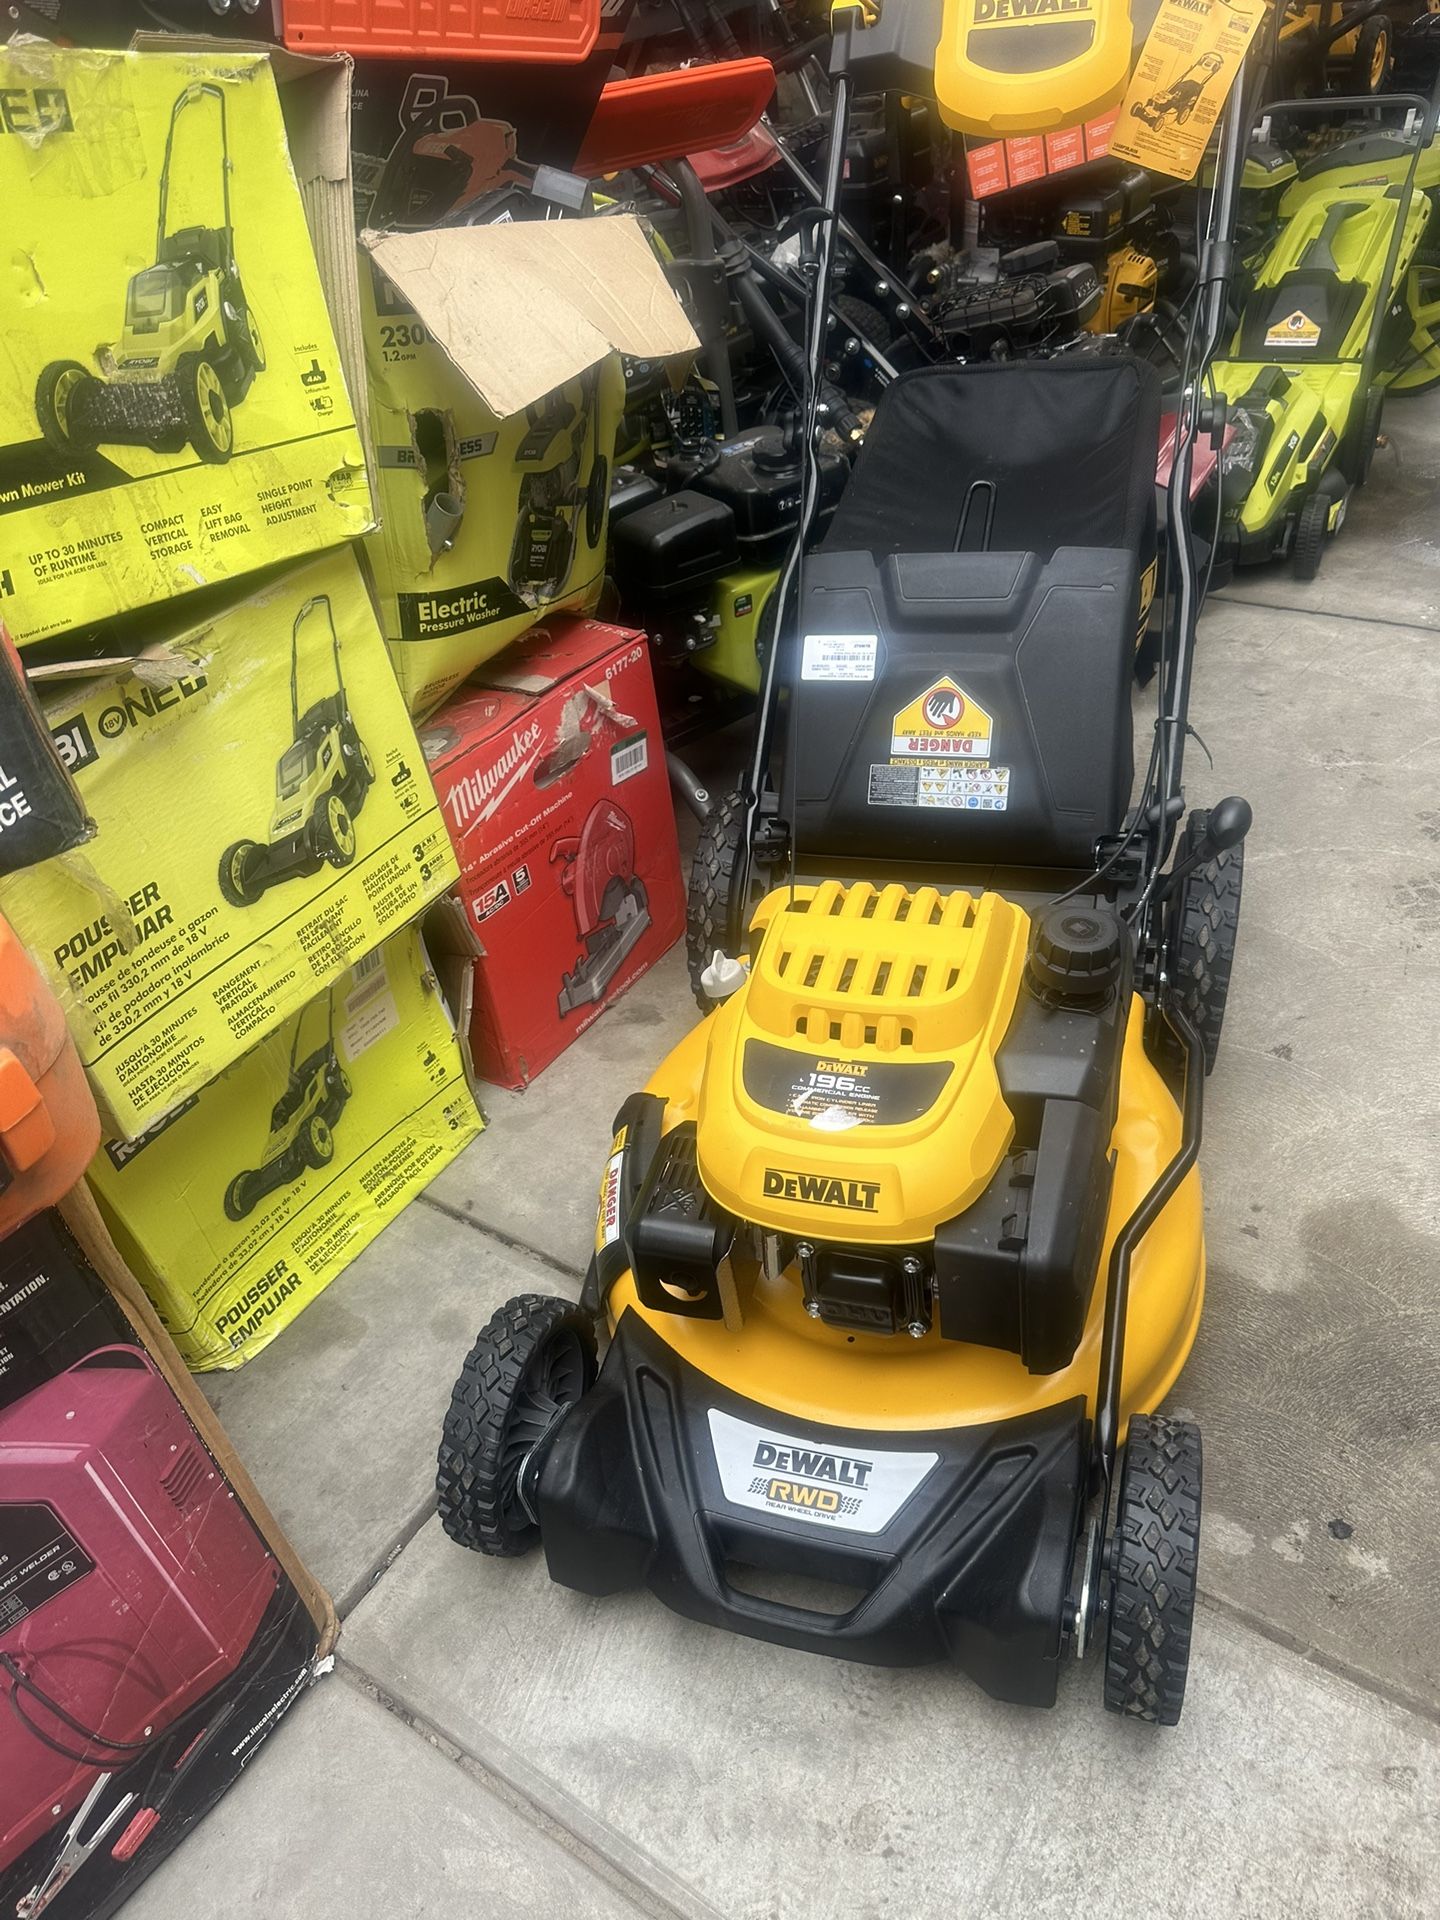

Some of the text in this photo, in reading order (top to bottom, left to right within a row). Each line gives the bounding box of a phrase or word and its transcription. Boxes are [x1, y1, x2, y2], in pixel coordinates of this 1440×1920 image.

[293, 343, 317, 352] Includes
[380, 324, 432, 348] 230
[397, 439, 482, 463] BRESS
[21, 479, 65, 498] Mower
[66, 472, 86, 487] Kit
[257, 479, 313, 501] SINGLE POINT
[200, 503, 222, 517] EASY
[205, 512, 242, 530] LIFT BAG
[261, 498, 292, 513] HEIGHT
[266, 504, 317, 526] ADJUSTMENT
[141, 514, 184, 533] COMPACT
[145, 528, 188, 547] VERTICAL
[209, 523, 251, 542] REMOVAL
[28, 531, 123, 565] UP TO 30 MINUTES
[150, 540, 193, 560] STORAGE
[34, 551, 97, 578] OF RUNTIME
[418, 592, 487, 621] Electric
[419, 607, 500, 633] Pressure Washer
[605, 646, 643, 680] 6177-20
[104, 715, 120, 731] 18V
[908, 738, 973, 752] DANGER
[443, 720, 543, 828] Milwaukee
[479, 836, 514, 863] Abrasive
[514, 813, 542, 837] Cut-Off
[542, 791, 573, 817] Machine
[390, 854, 399, 864] DE
[412, 833, 437, 862] 3 ANS
[364, 869, 393, 893] HAUTEUR
[367, 862, 412, 901] POINT UNIQUE
[420, 863, 432, 881] 3
[372, 883, 403, 912] AJUSTE DE
[375, 881, 418, 919] ALTURA DE UN
[476, 883, 508, 913] 15A
[516, 868, 526, 881] 5
[296, 895, 349, 938] RETRAIT DU SAC
[377, 892, 417, 926] SOLO PUNTO
[54, 881, 161, 970] POUSER
[299, 934, 311, 945] EN
[117, 907, 219, 981] de tondeuse gazon
[307, 942, 331, 964] RETIRO
[311, 935, 353, 970] DE LA BOLSA
[108, 925, 208, 1003] fil 330,2 mm de 18 V
[108, 1010, 122, 1023] de
[123, 972, 171, 1013] podadora
[172, 932, 230, 975] inalámbrica
[212, 960, 261, 999] RANGEMENT
[314, 963, 331, 977] CON
[216, 978, 253, 1006] VERTICAL
[220, 982, 259, 1014] PRATIQUE
[227, 970, 296, 1026] ALMACENAMIENTO
[99, 970, 192, 1047] de 330,2 mm y 18 V
[230, 1004, 266, 1032] VERTICAL
[235, 1005, 276, 1040] COMPACTO
[150, 1035, 161, 1046] 30
[161, 1007, 198, 1038] MINUTES
[118, 1033, 177, 1082] D'AUTONOMIE
[128, 1036, 205, 1099] HASTA 30 MINUTOS
[816, 1060, 869, 1077] DEWALT
[132, 1094, 146, 1106] DE
[791, 1084, 881, 1100] COMMERCIAL ENGINE
[449, 1119, 458, 1130] 3
[359, 1141, 406, 1184] MISE MARCHE
[374, 1161, 416, 1204] ARRANQUE POR
[377, 1179, 407, 1209] PULSADOR
[606, 1168, 618, 1227] DANGER
[763, 1169, 881, 1212] DEWALT
[316, 1215, 326, 1224] 30
[325, 1190, 352, 1216] MINUTES
[192, 1180, 307, 1298] Tondeuse gazon 33,02 cm de 18 V
[294, 1213, 338, 1254] D'AUTONOMIE
[304, 1246, 326, 1266] HASTA
[324, 1238, 333, 1247] 30
[332, 1212, 361, 1240] MINUTOS
[196, 1207, 291, 1304] Podadora de 33,02 cm 18 V
[309, 1261, 320, 1271] DE
[0, 1274, 50, 1316] NTATION.
[214, 1258, 289, 1335] POUSSER
[228, 1272, 303, 1349] EMPUJAR
[753, 1441, 873, 1489] DEWALT
[765, 1501, 837, 1521] REAR WHEEL DRIVE
[768, 1480, 841, 1511] RWD
[19, 1545, 60, 1576] WELDER
[231, 1667, 308, 1756] www.lincolnelectric.com
